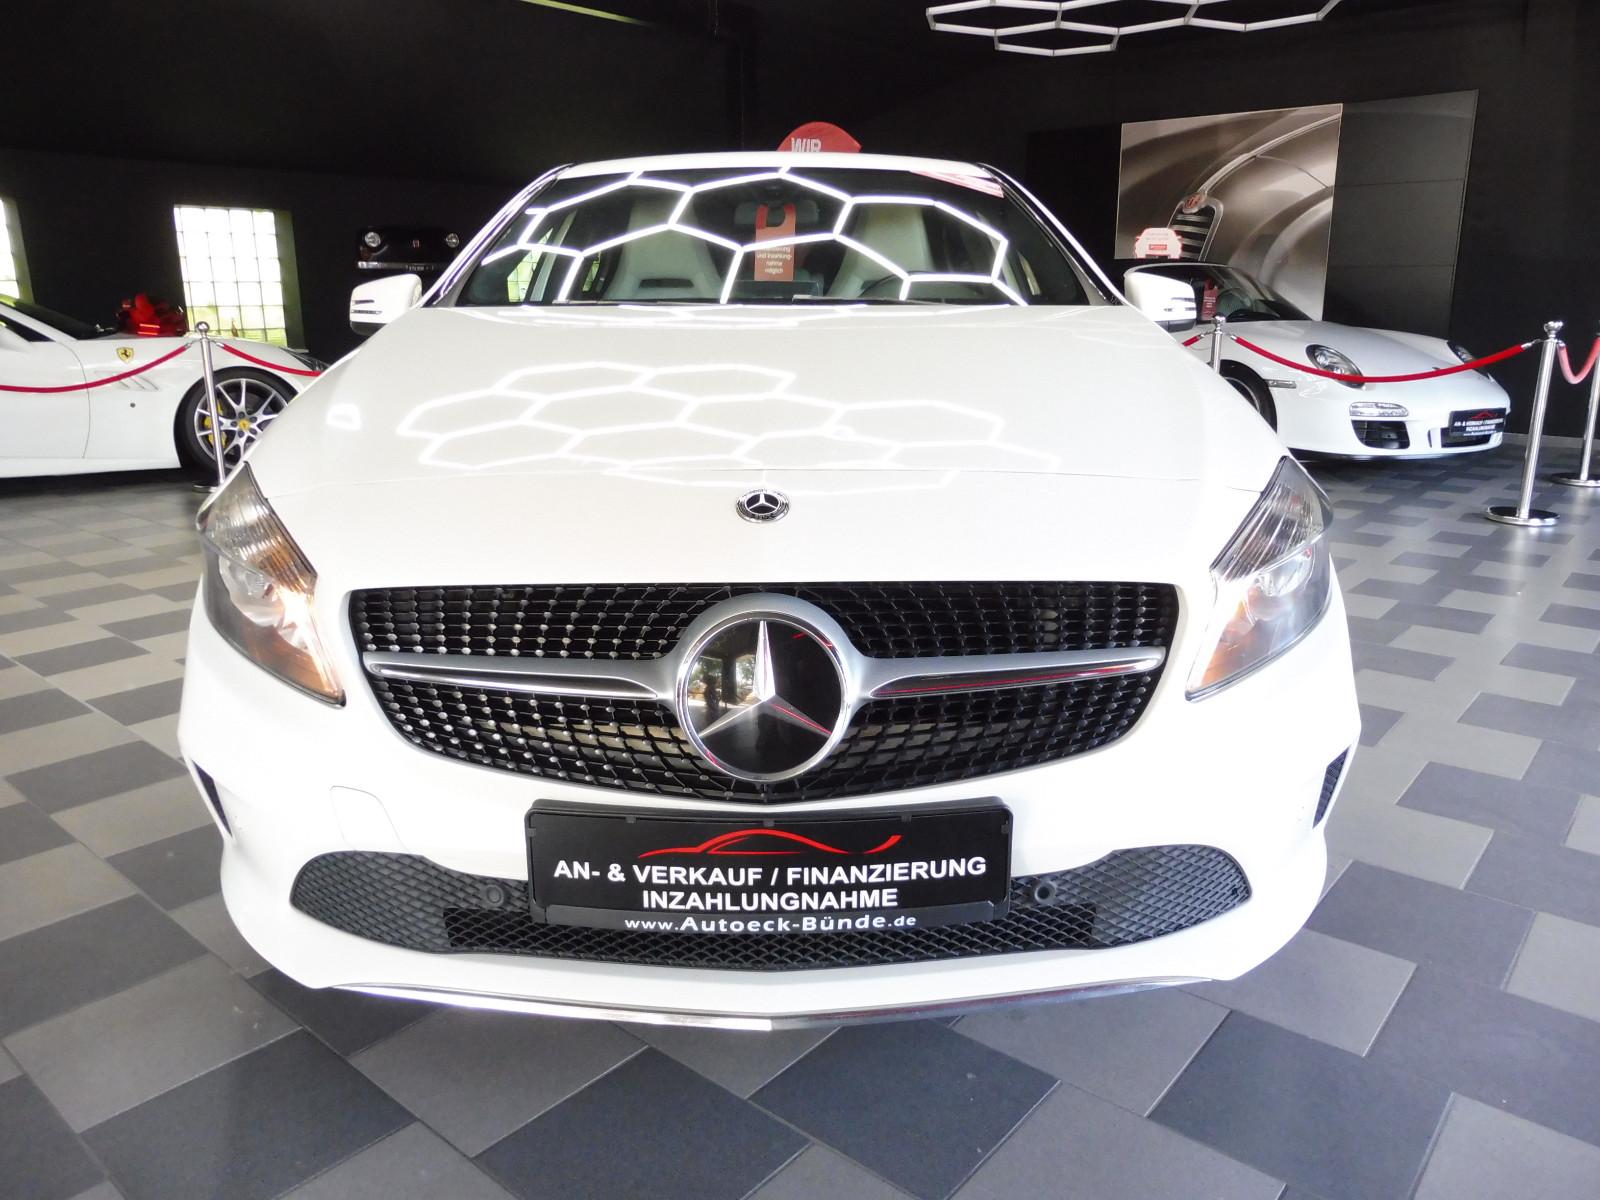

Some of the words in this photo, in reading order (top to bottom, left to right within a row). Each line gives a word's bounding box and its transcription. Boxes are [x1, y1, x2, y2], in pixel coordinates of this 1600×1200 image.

[553, 859, 601, 880] AN-
[607, 863, 626, 882] &
[632, 864, 763, 886] VERKAUF
[770, 867, 779, 886] /
[786, 856, 987, 886] FINANZIERUNG
[642, 888, 898, 911] INZAHLUNGNAHME
[624, 914, 917, 933] www.Autoeck-Bünde.de
